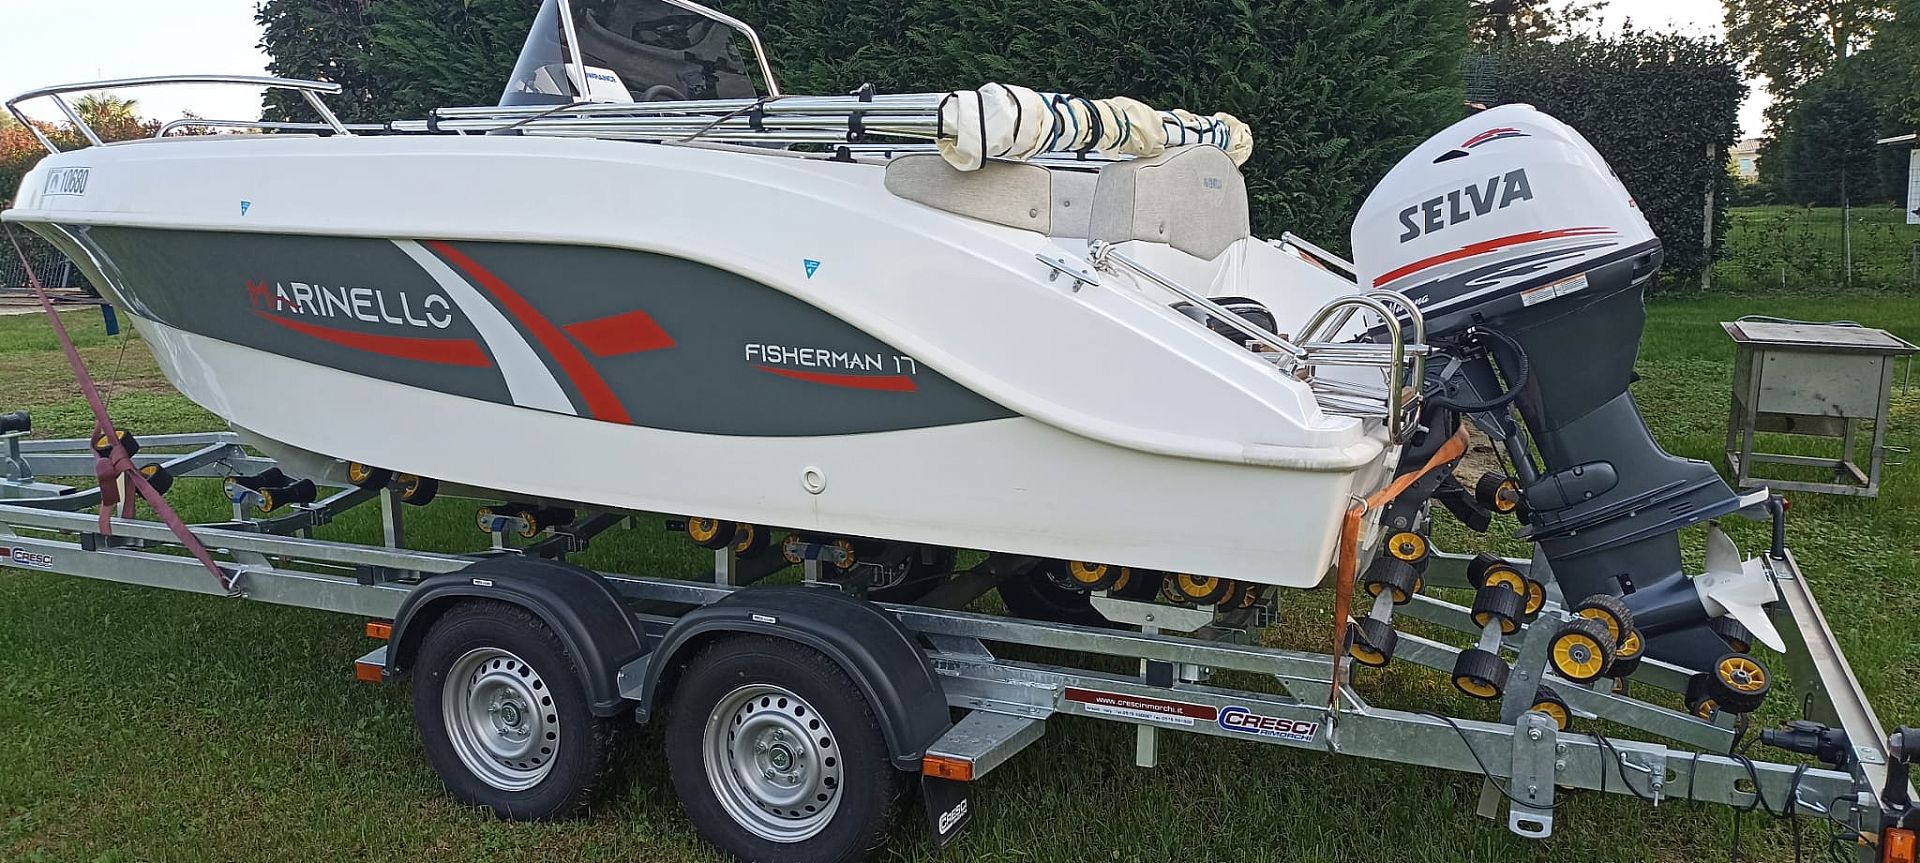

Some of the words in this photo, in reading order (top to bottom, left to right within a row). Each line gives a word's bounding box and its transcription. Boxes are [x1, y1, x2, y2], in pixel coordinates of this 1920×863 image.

[1399, 167, 1534, 244] SELVA
[245, 280, 452, 330] MARINELLO
[745, 343, 883, 372] FISHERMAN
[892, 355, 917, 375] 17
[13, 548, 53, 564] CRESCI
[1220, 707, 1319, 736] CRESCI
[1260, 729, 1312, 742] RIMORCHI
